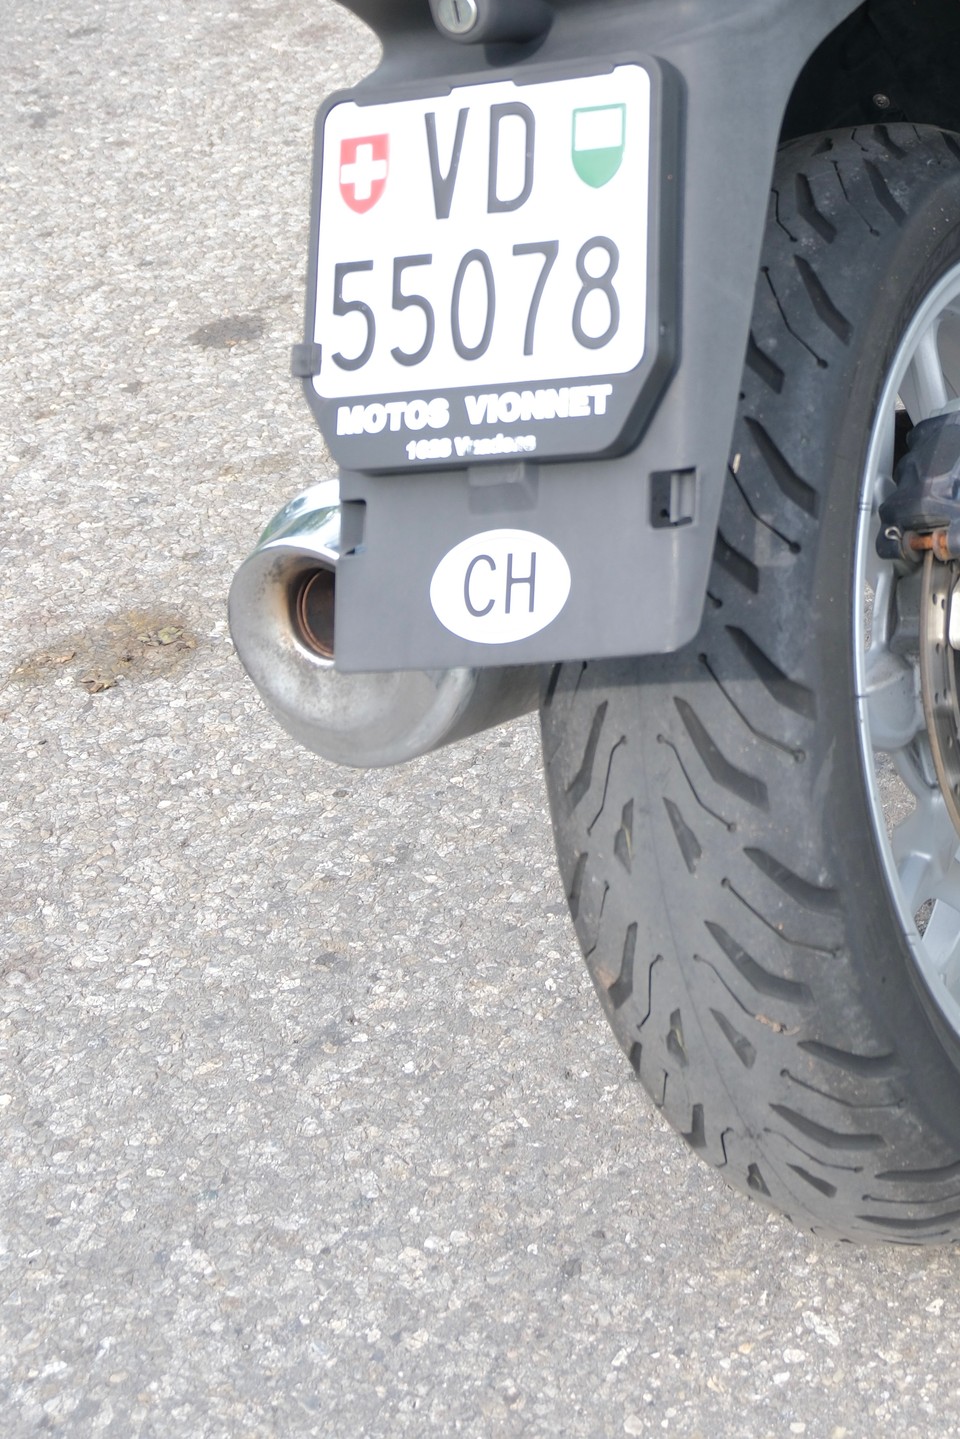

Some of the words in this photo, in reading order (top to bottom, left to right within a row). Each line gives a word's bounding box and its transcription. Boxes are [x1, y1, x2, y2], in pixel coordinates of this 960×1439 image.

[424, 101, 536, 219] VD
[331, 235, 620, 371] 55078
[336, 397, 450, 435] MOTOS
[464, 383, 613, 425] VIONNET
[463, 551, 537, 617] CH
